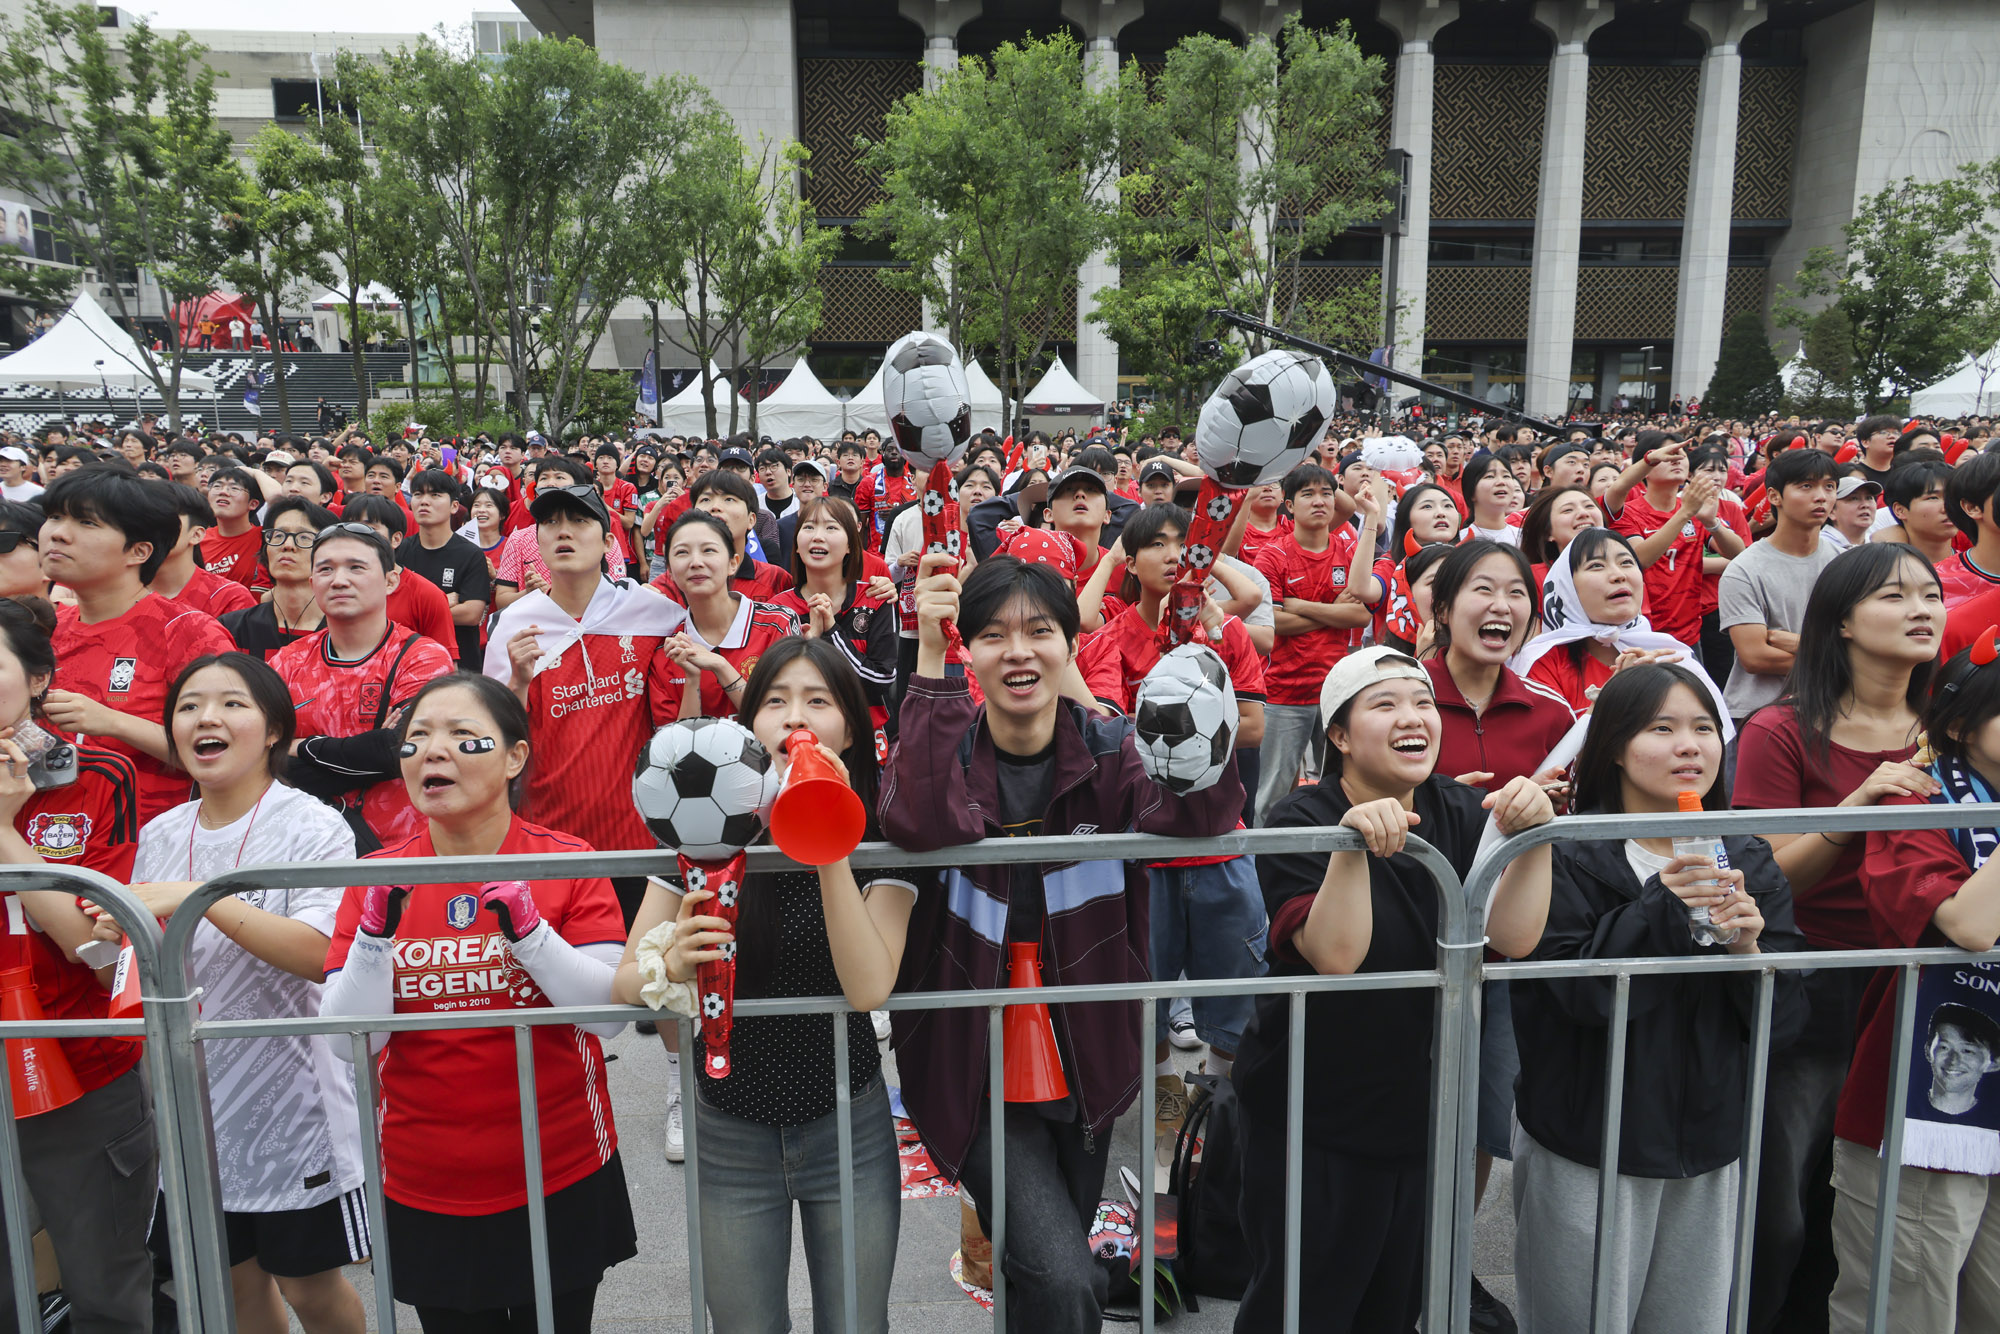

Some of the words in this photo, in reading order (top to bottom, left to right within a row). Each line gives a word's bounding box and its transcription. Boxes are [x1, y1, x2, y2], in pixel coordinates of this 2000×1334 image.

[1665, 548, 1677, 571] 7
[106, 695, 128, 703] KOREA
[550, 688, 623, 718] Chartered
[37, 846, 81, 856] Leverkusen
[393, 934, 503, 969] KOREA
[1953, 970, 2000, 996] SON
[433, 1001, 457, 1010] begin
[458, 999, 468, 1008] to
[469, 997, 490, 1007] 2010
[23, 1047, 37, 1062] kt
[24, 1061, 39, 1092] skylife
